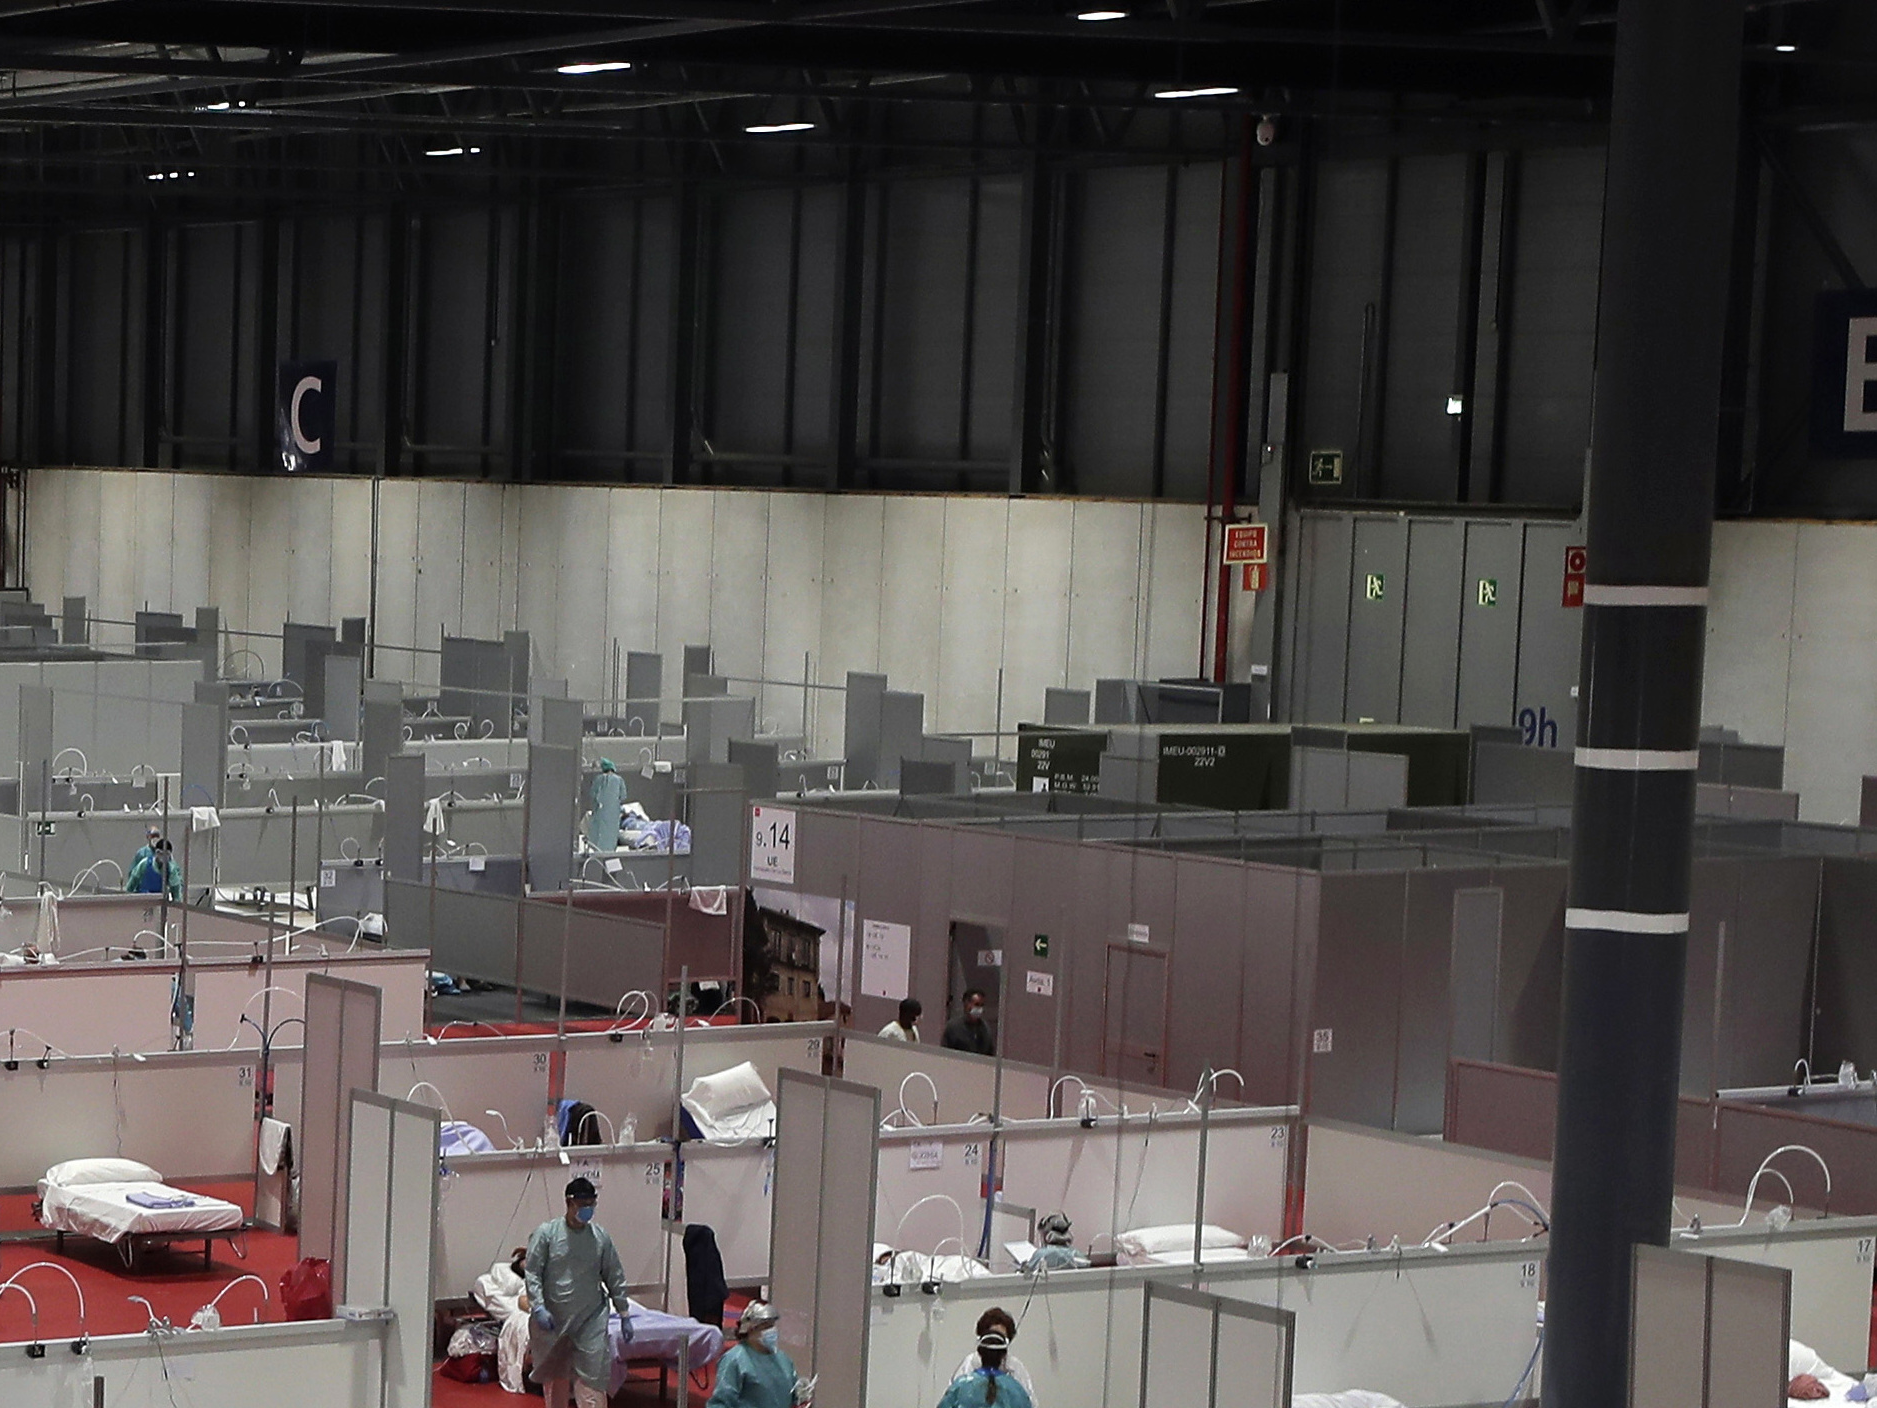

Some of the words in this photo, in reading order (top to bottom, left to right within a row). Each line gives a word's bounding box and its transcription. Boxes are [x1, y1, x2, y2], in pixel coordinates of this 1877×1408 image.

[291, 376, 321, 453] C
[1519, 706, 1557, 748] 9h
[757, 822, 793, 850] 9.14
[768, 854, 779, 867] UE
[964, 1144, 979, 1157] 24
[645, 1162, 660, 1176] 25
[1858, 1239, 1871, 1253] 17
[1522, 1263, 1536, 1277] 18
